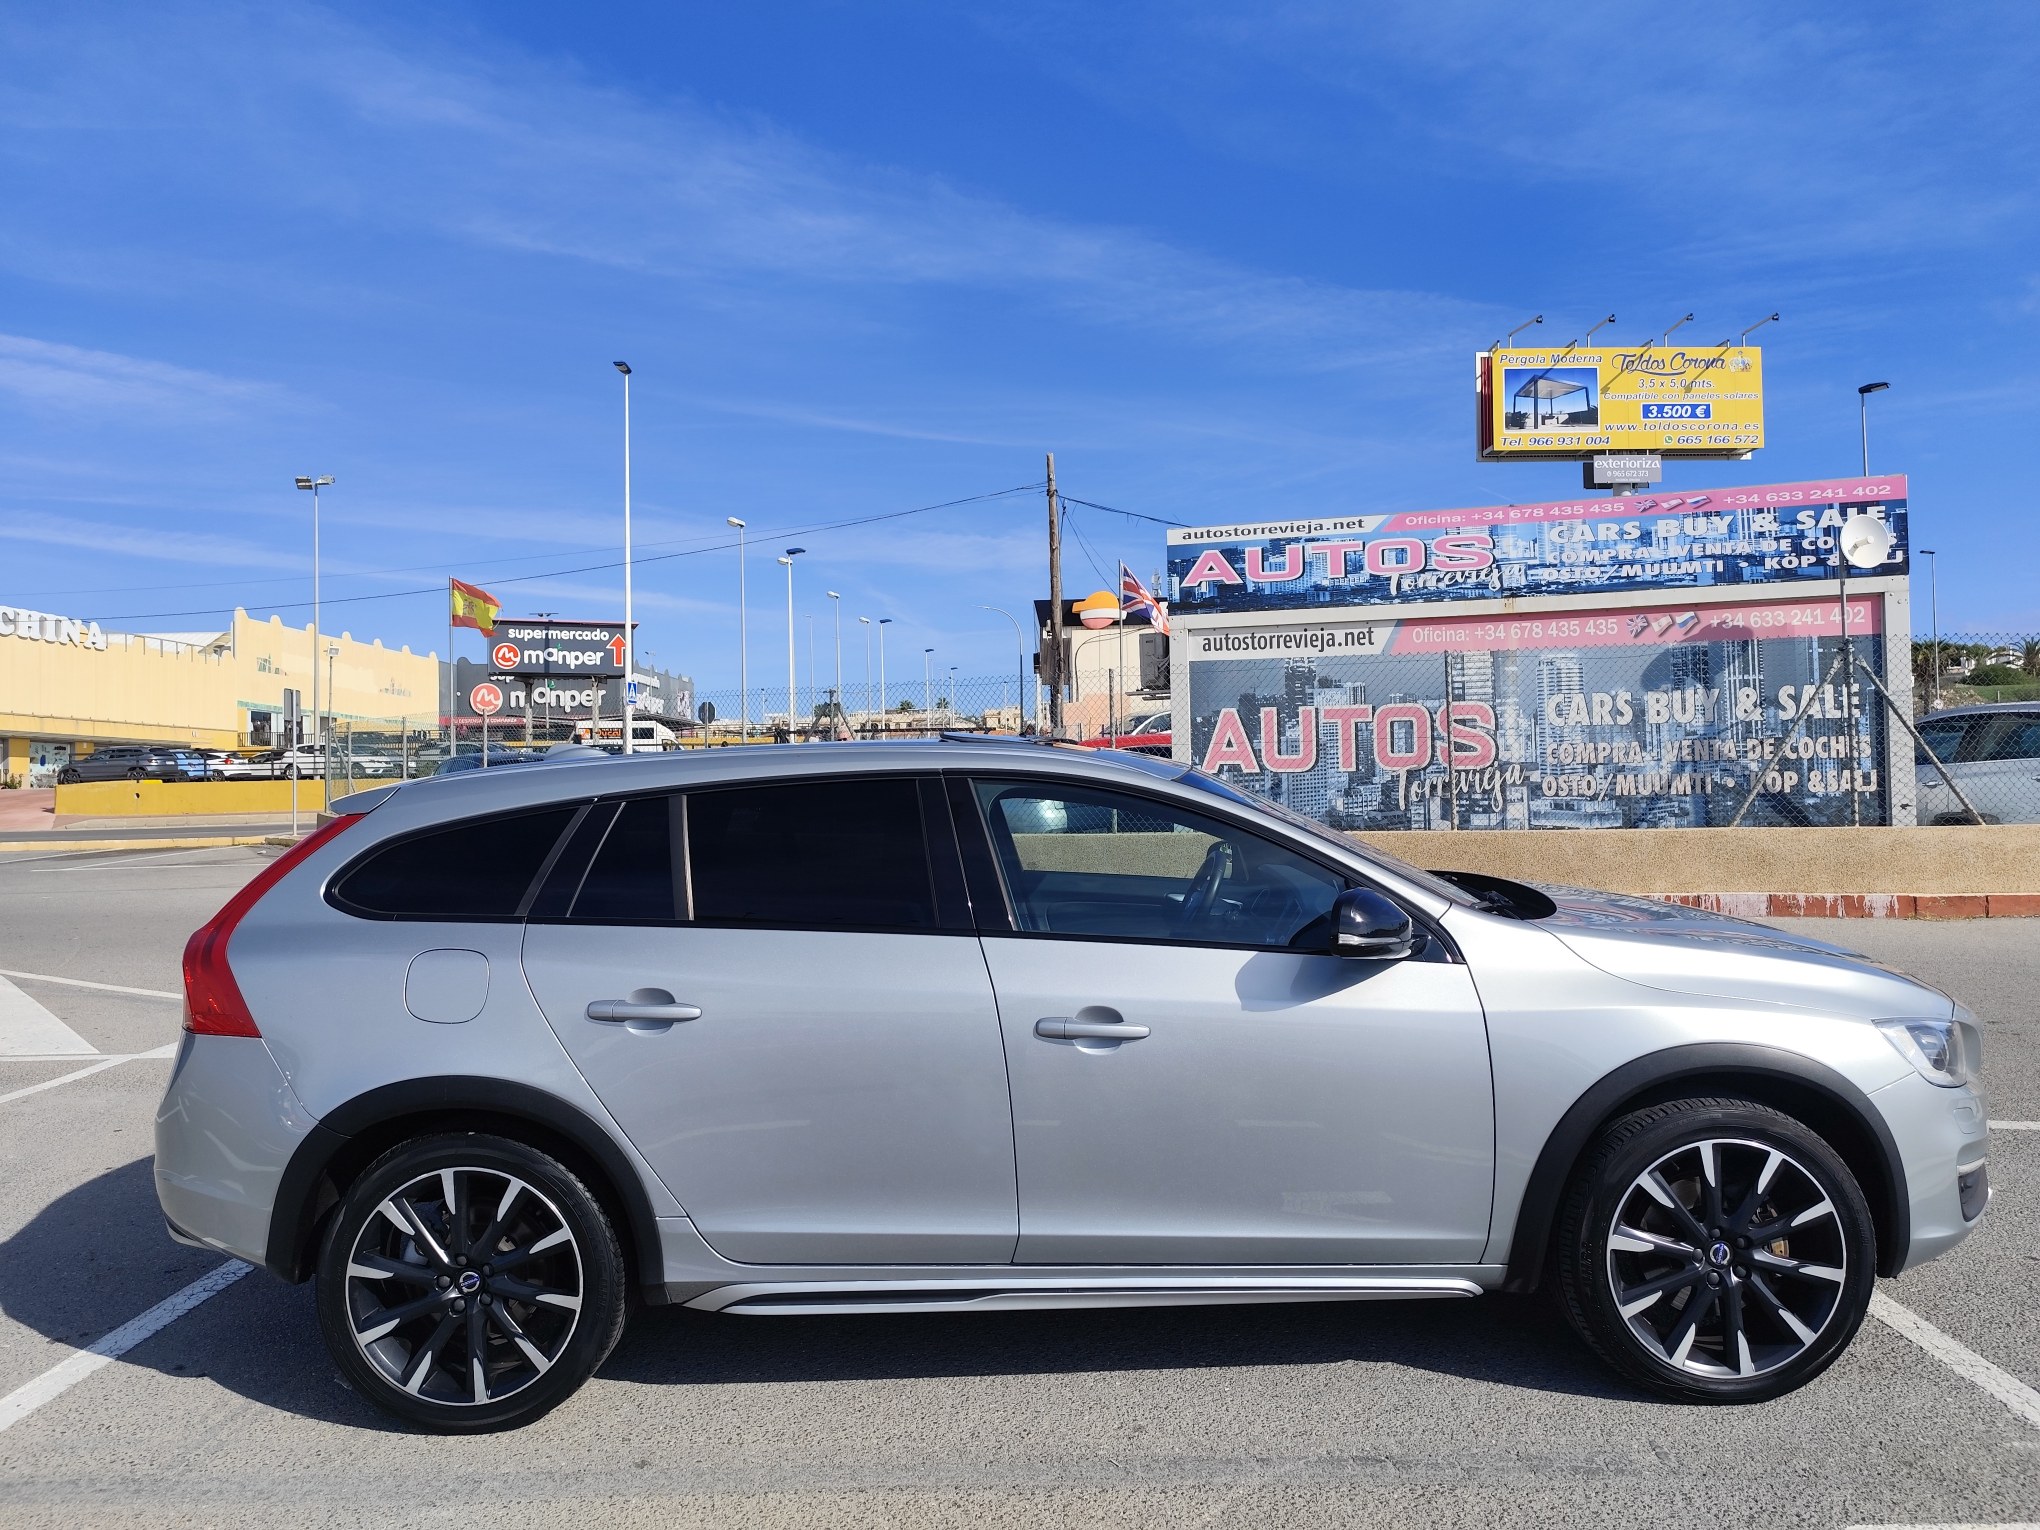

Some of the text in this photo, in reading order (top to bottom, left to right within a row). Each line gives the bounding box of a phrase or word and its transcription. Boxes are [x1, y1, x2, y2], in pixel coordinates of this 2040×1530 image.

[1550, 354, 1602, 364] Moderna
[1670, 352, 1726, 371] Corona
[1638, 378, 1656, 389] 3,5
[1669, 378, 1687, 390] 5,0
[1690, 379, 1716, 388] mts.
[1603, 392, 1659, 401] Compatible
[1683, 392, 1721, 401] paneles
[1647, 405, 1707, 418] 3.500 €
[1604, 421, 1760, 431] www.toldoscorona.es
[1501, 436, 1610, 446] Tel. 966 931 004
[1677, 435, 1759, 444] 665 166 572
[1594, 457, 1660, 469] exterioriza
[1724, 485, 1891, 504] +34 633 241 402
[1405, 502, 1625, 526] Oficina: +34 678 435 435
[1181, 518, 1365, 541] autostorrevieja.net
[1550, 521, 1642, 544] CARS
[1656, 515, 1734, 539] BUY
[1752, 513, 1781, 532] &
[1549, 533, 1898, 564] COMPRA VENTA DE COS
[1180, 534, 1498, 587] AUTOS
[1764, 553, 1817, 570] KÖP
[0, 605, 105, 650] CHINA
[1710, 606, 1865, 629] +34 633 241 402
[507, 628, 610, 641] supermercado
[1202, 627, 1375, 652] autostorrevieja.net
[1412, 619, 1619, 643] Oficina: +34 678 435 435
[523, 647, 605, 670] manper
[509, 686, 607, 713] manper
[1547, 684, 1861, 727] CARS BUY & SALE
[1200, 700, 1499, 774] AUTOS
[1547, 736, 1872, 765] COMPRA VENTA DE COCHES
[1393, 761, 1527, 812] Torrevieja
